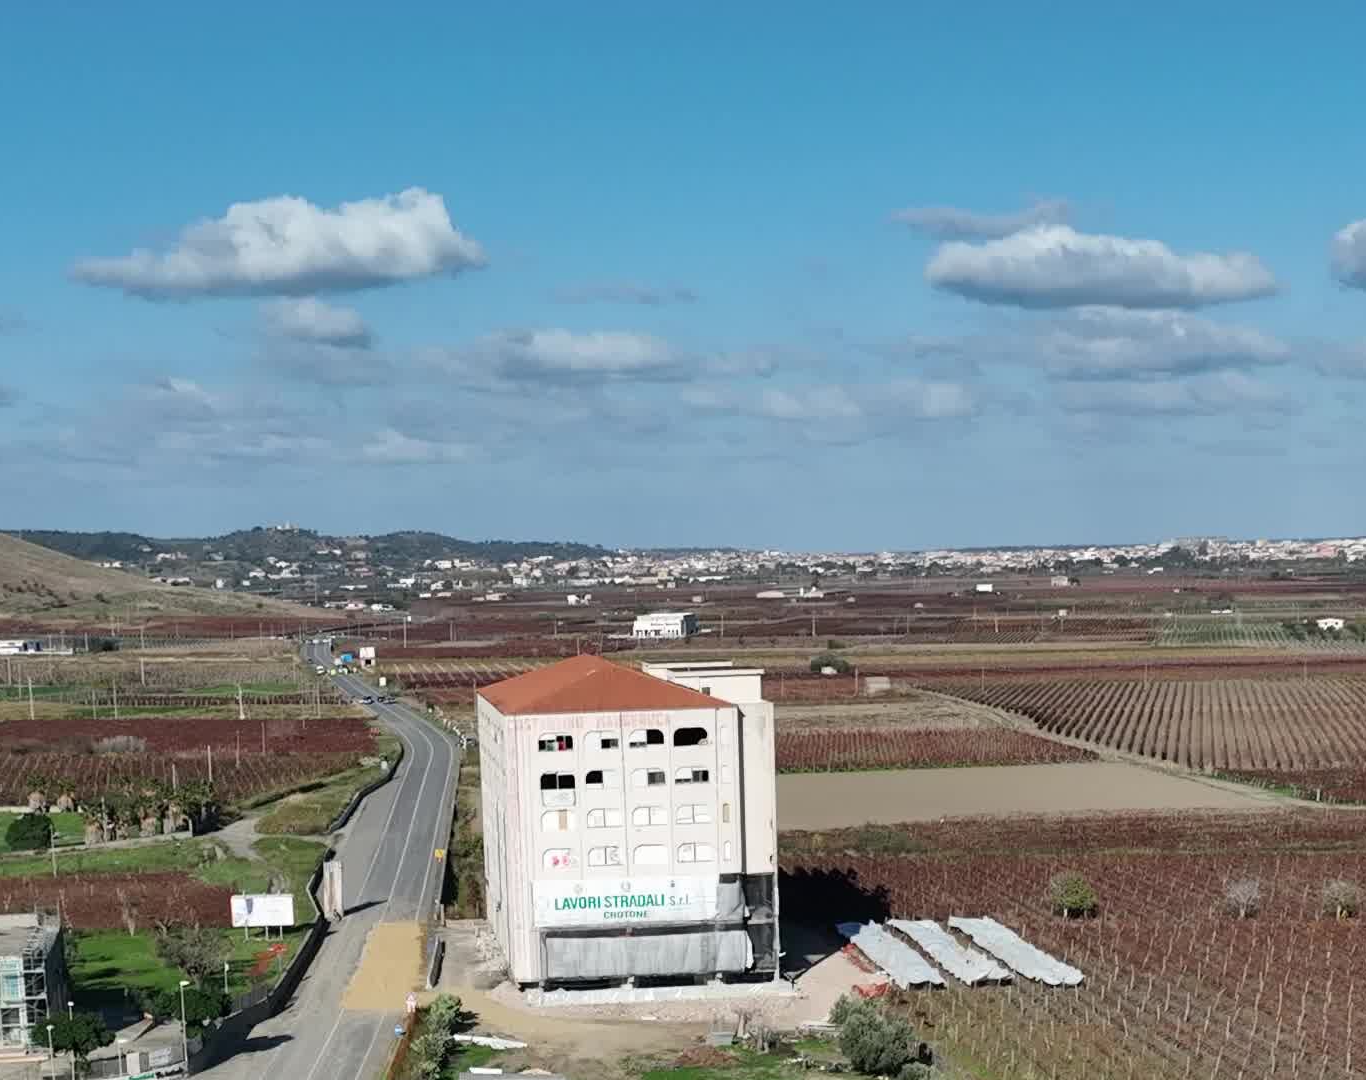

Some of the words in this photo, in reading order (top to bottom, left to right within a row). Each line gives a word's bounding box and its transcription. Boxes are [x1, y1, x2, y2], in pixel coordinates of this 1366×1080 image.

[554, 896, 601, 911] LAVORI
[604, 894, 665, 908] STRADALI
[603, 910, 649, 920] CROTONE
